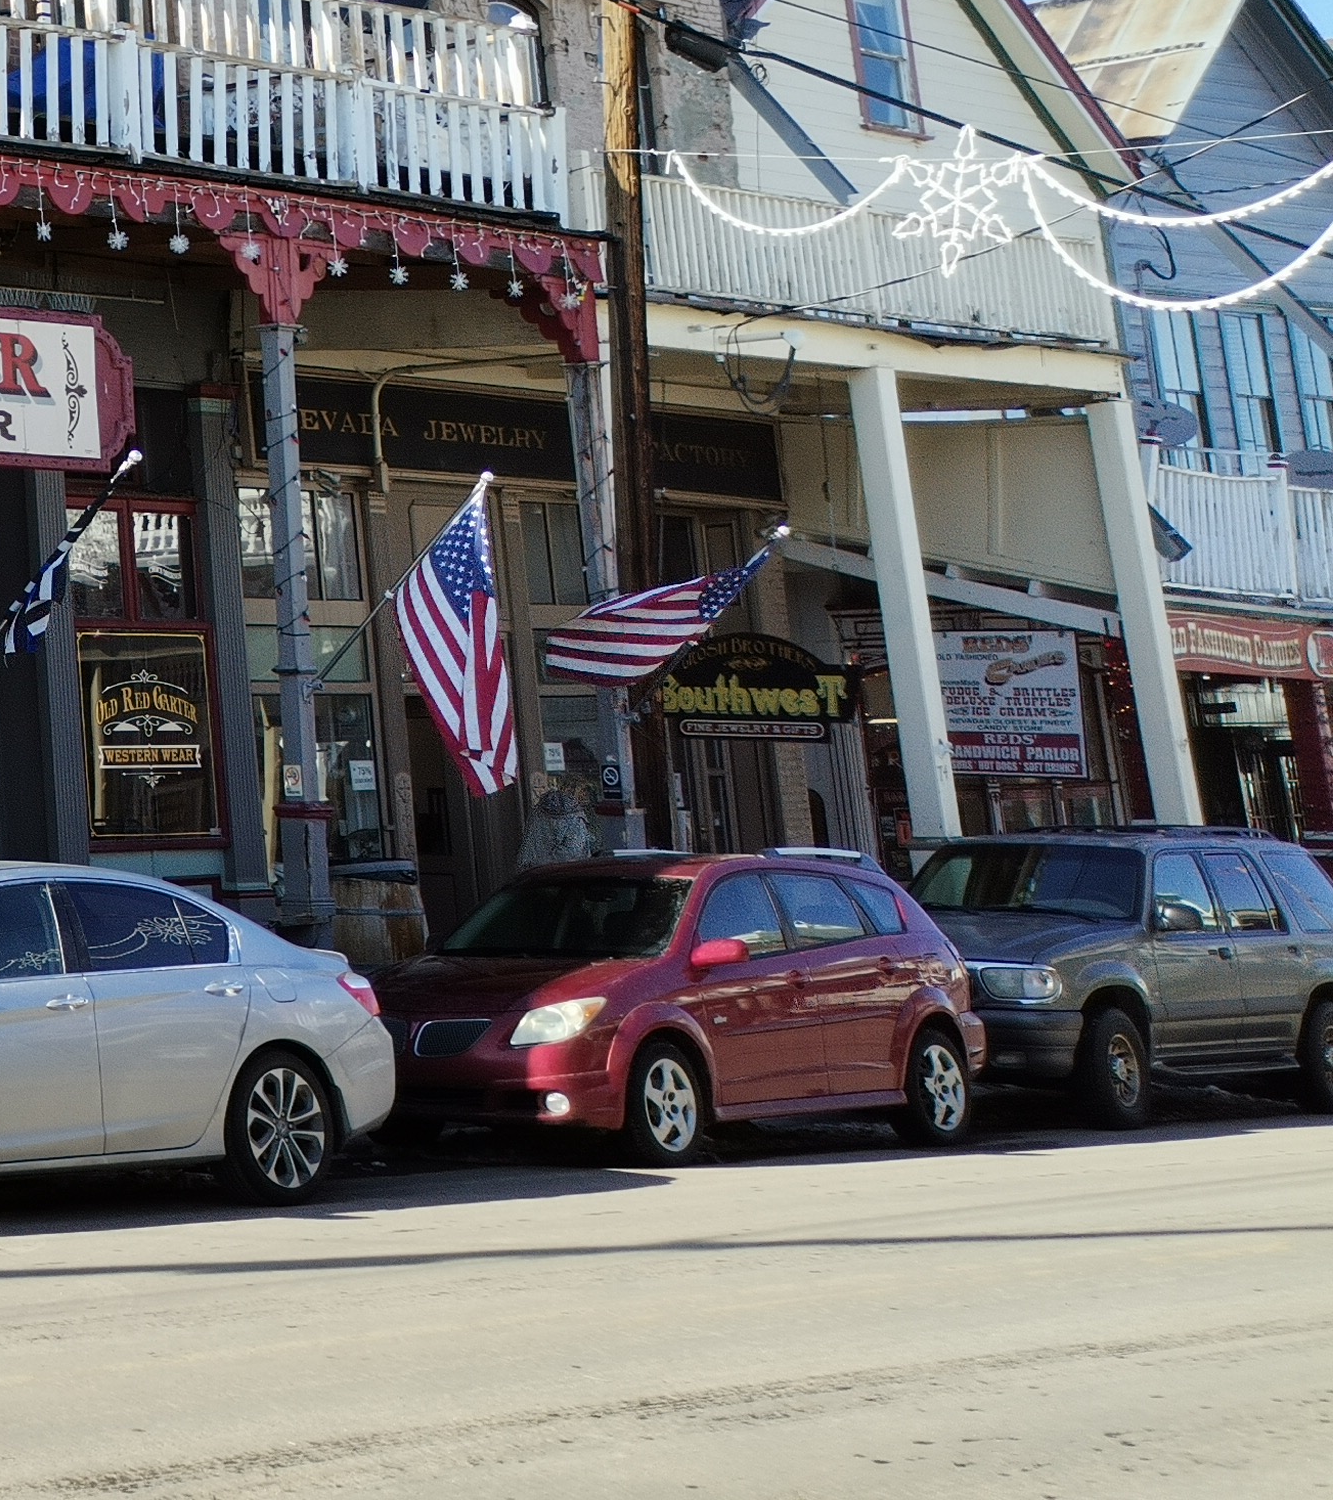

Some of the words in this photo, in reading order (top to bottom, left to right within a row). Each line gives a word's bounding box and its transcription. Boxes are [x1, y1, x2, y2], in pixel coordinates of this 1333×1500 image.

[299, 408, 400, 437] EVADA
[424, 419, 547, 450] JEWELRY
[1171, 627, 1187, 655] LD
[1013, 687, 1077, 698] BRITTLES
[95, 698, 118, 725] OLD
[122, 687, 150, 712] RED
[152, 686, 198, 724] GARTER
[947, 696, 996, 706] DELUXE
[1005, 697, 1071, 707] TRUFFLES
[972, 707, 990, 716] ICE
[999, 707, 1047, 717] CREAM
[686, 722, 712, 733] FINE
[715, 723, 770, 735] JEWELRY
[784, 724, 818, 736] GIFTS
[105, 749, 159, 763] WESTERN
[162, 749, 194, 762] WEAR
[953, 745, 1021, 760] ANDWICH
[1027, 747, 1080, 762] PARLOR
